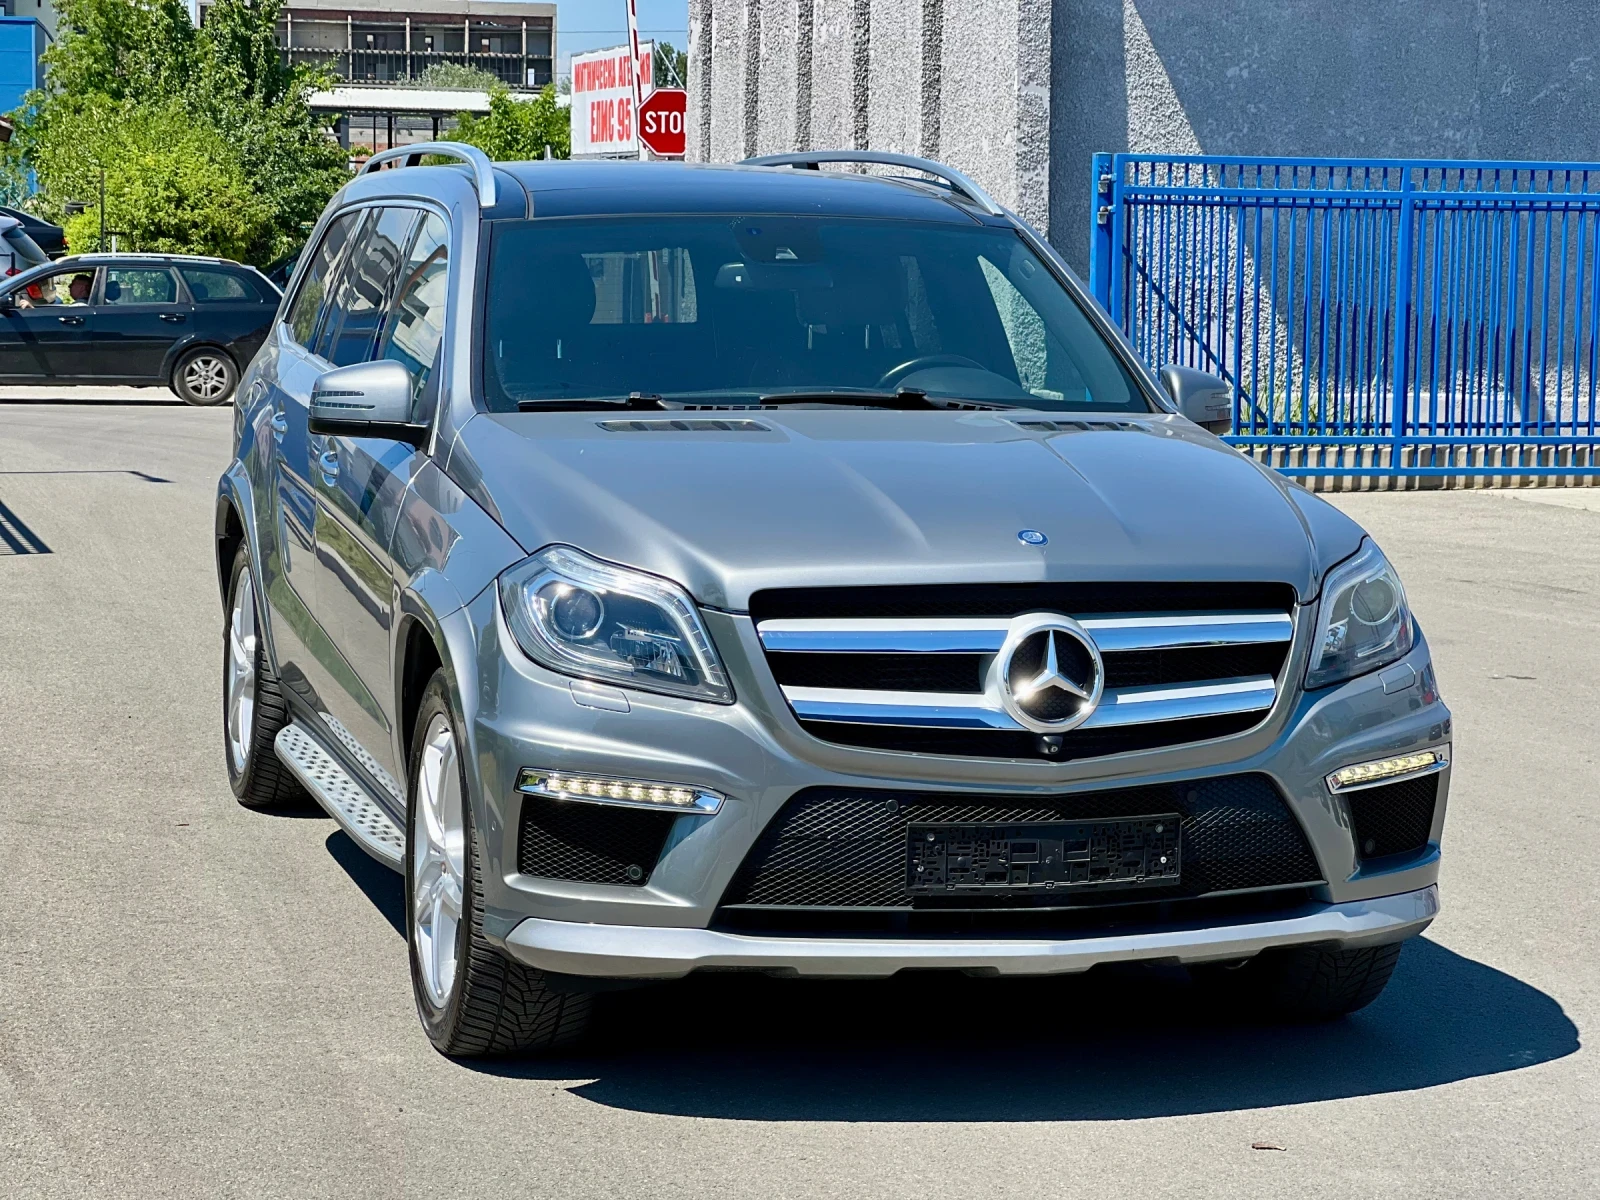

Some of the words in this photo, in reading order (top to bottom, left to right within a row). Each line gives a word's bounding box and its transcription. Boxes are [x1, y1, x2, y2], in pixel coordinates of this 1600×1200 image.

[574, 57, 616, 93] МИТНИЧЕСКА
[618, 52, 650, 87] АГЕИЯ
[590, 99, 614, 143] ЕЛИС
[617, 98, 632, 142] 95
[645, 111, 686, 133] STO
